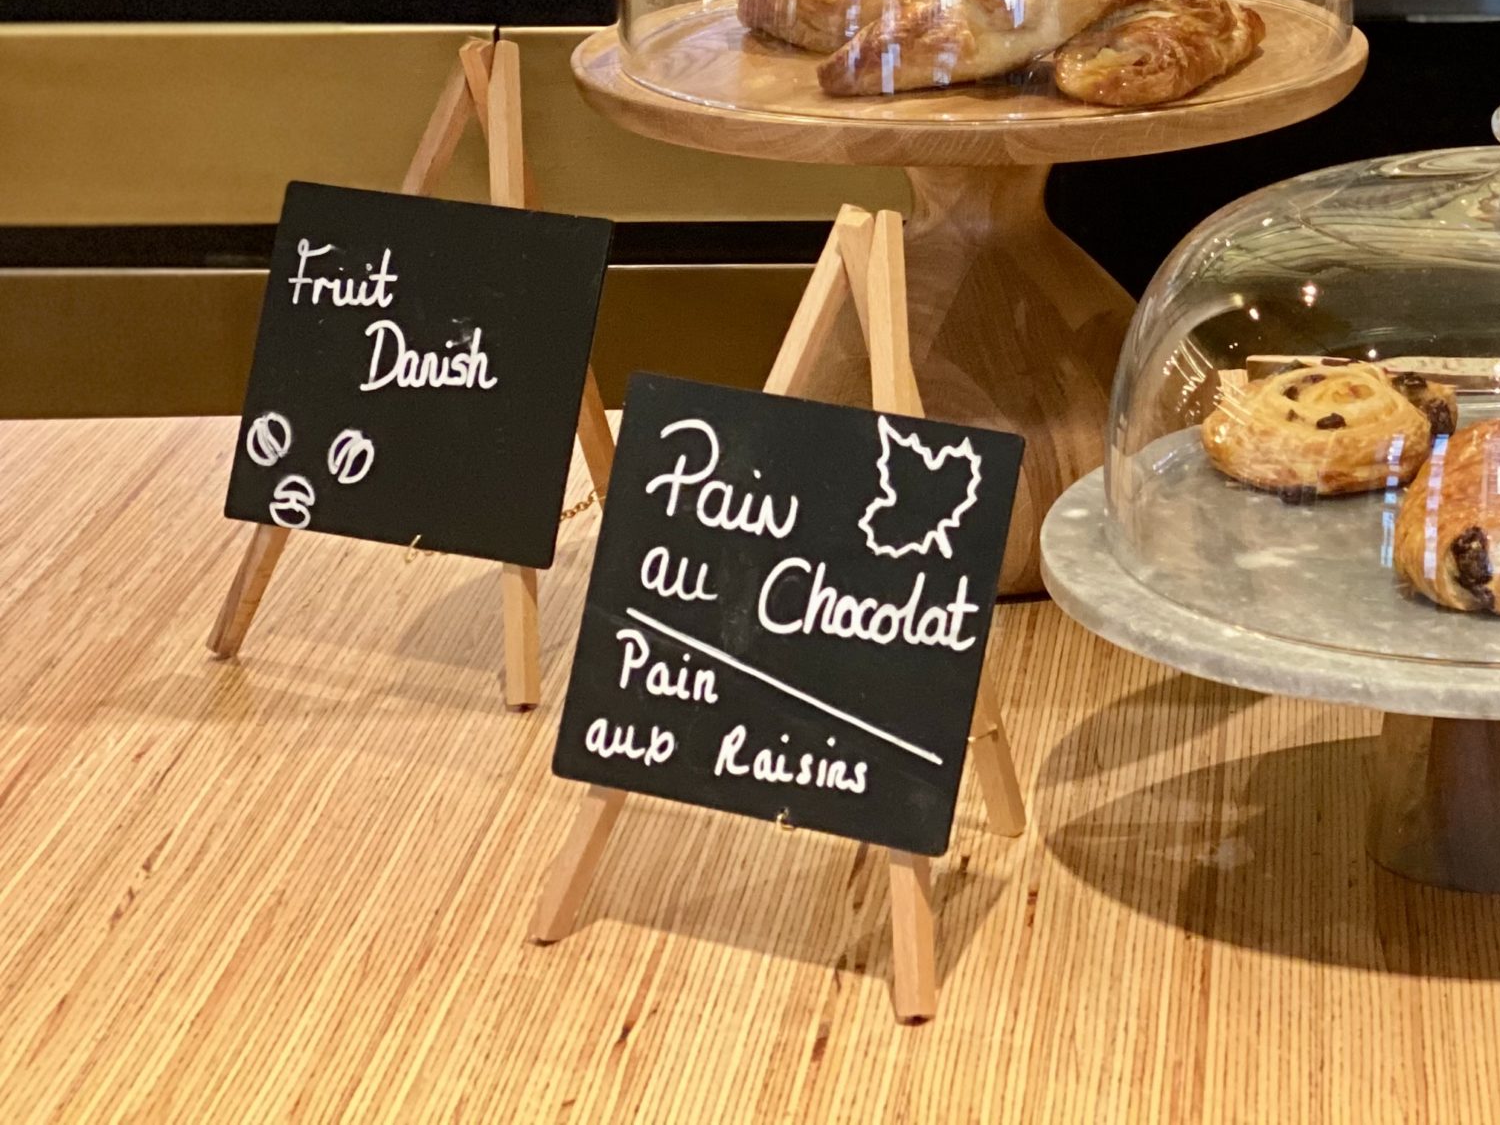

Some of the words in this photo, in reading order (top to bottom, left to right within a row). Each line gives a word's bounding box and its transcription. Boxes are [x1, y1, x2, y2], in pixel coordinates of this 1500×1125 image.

[287, 237, 399, 308] Fruit
[358, 318, 499, 393] Danish
[644, 417, 800, 539] Pain
[639, 545, 719, 602] au
[756, 555, 981, 653] Chocolat
[615, 627, 719, 705] Pain
[712, 723, 869, 795] Raisins
